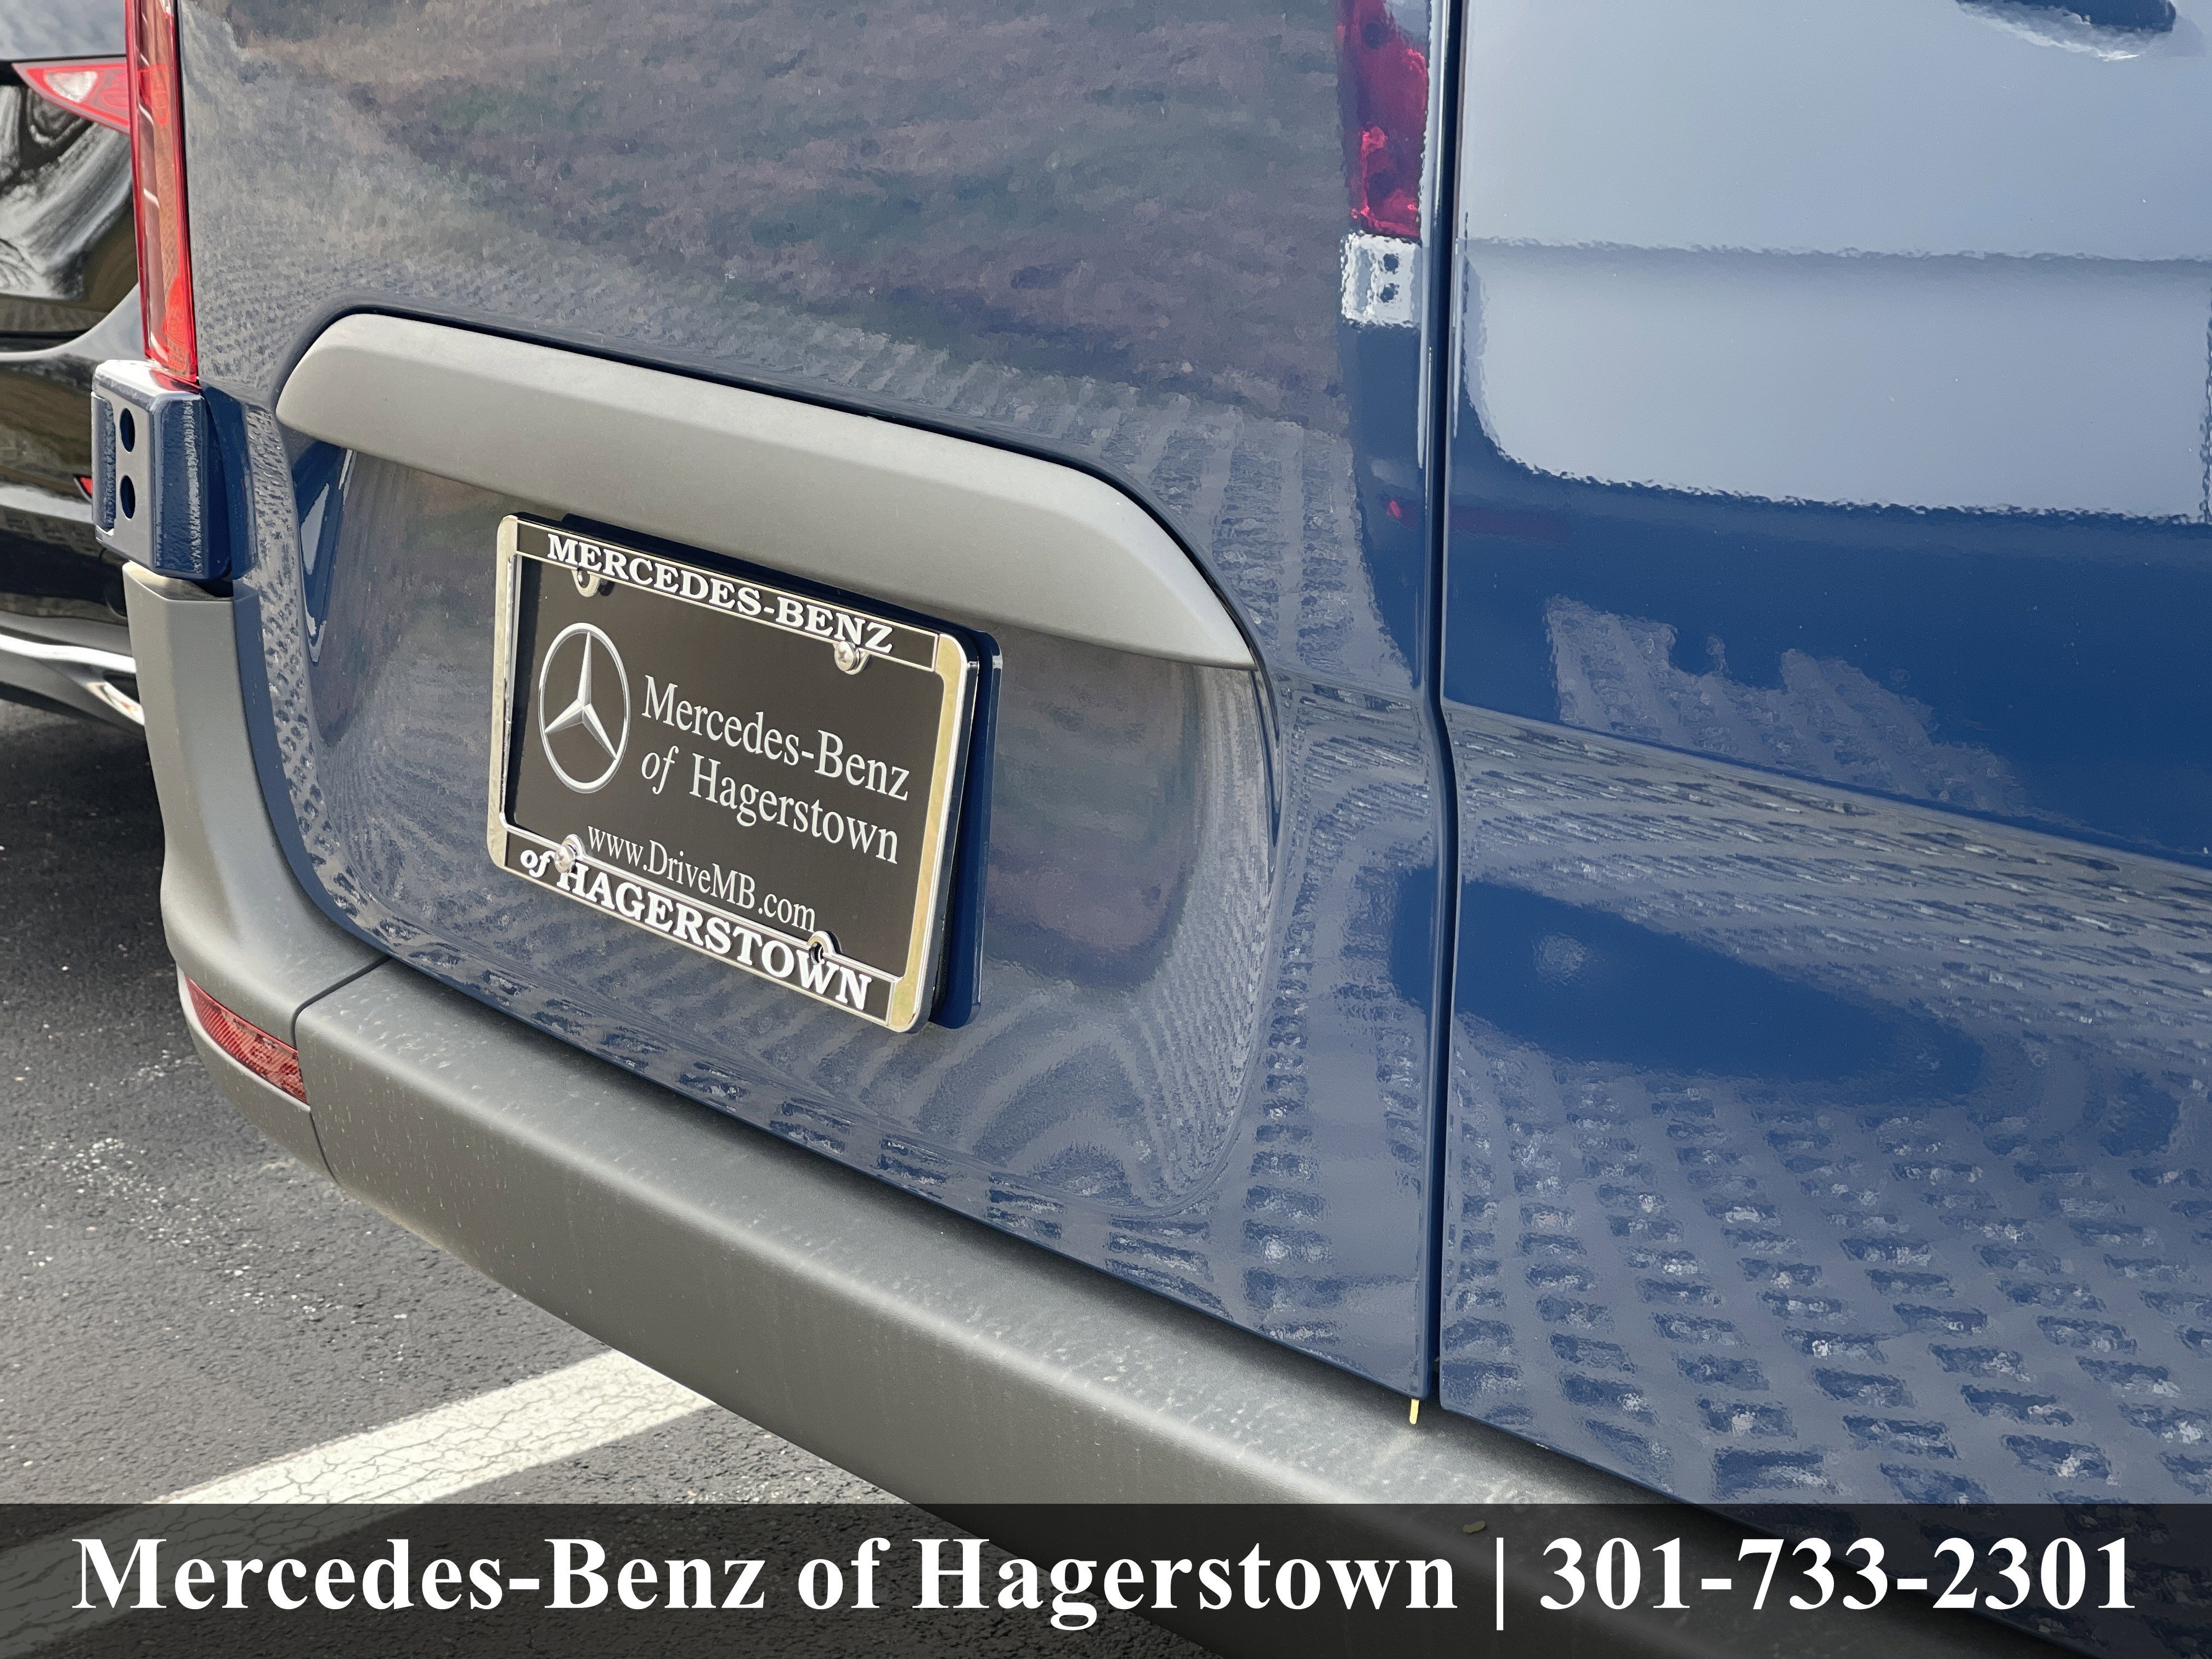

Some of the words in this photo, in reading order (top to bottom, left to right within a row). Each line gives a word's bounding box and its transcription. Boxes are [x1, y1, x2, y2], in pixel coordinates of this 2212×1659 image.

[548, 533, 894, 654] MERCEDES-BENZ
[643, 675, 910, 801] Mercedes-Benz
[641, 746, 679, 794] of
[690, 754, 899, 865] Hagerstown
[520, 849, 555, 878] of
[556, 862, 872, 1009] HAGERSTOWN
[588, 825, 817, 932] www.DriveMB.com
